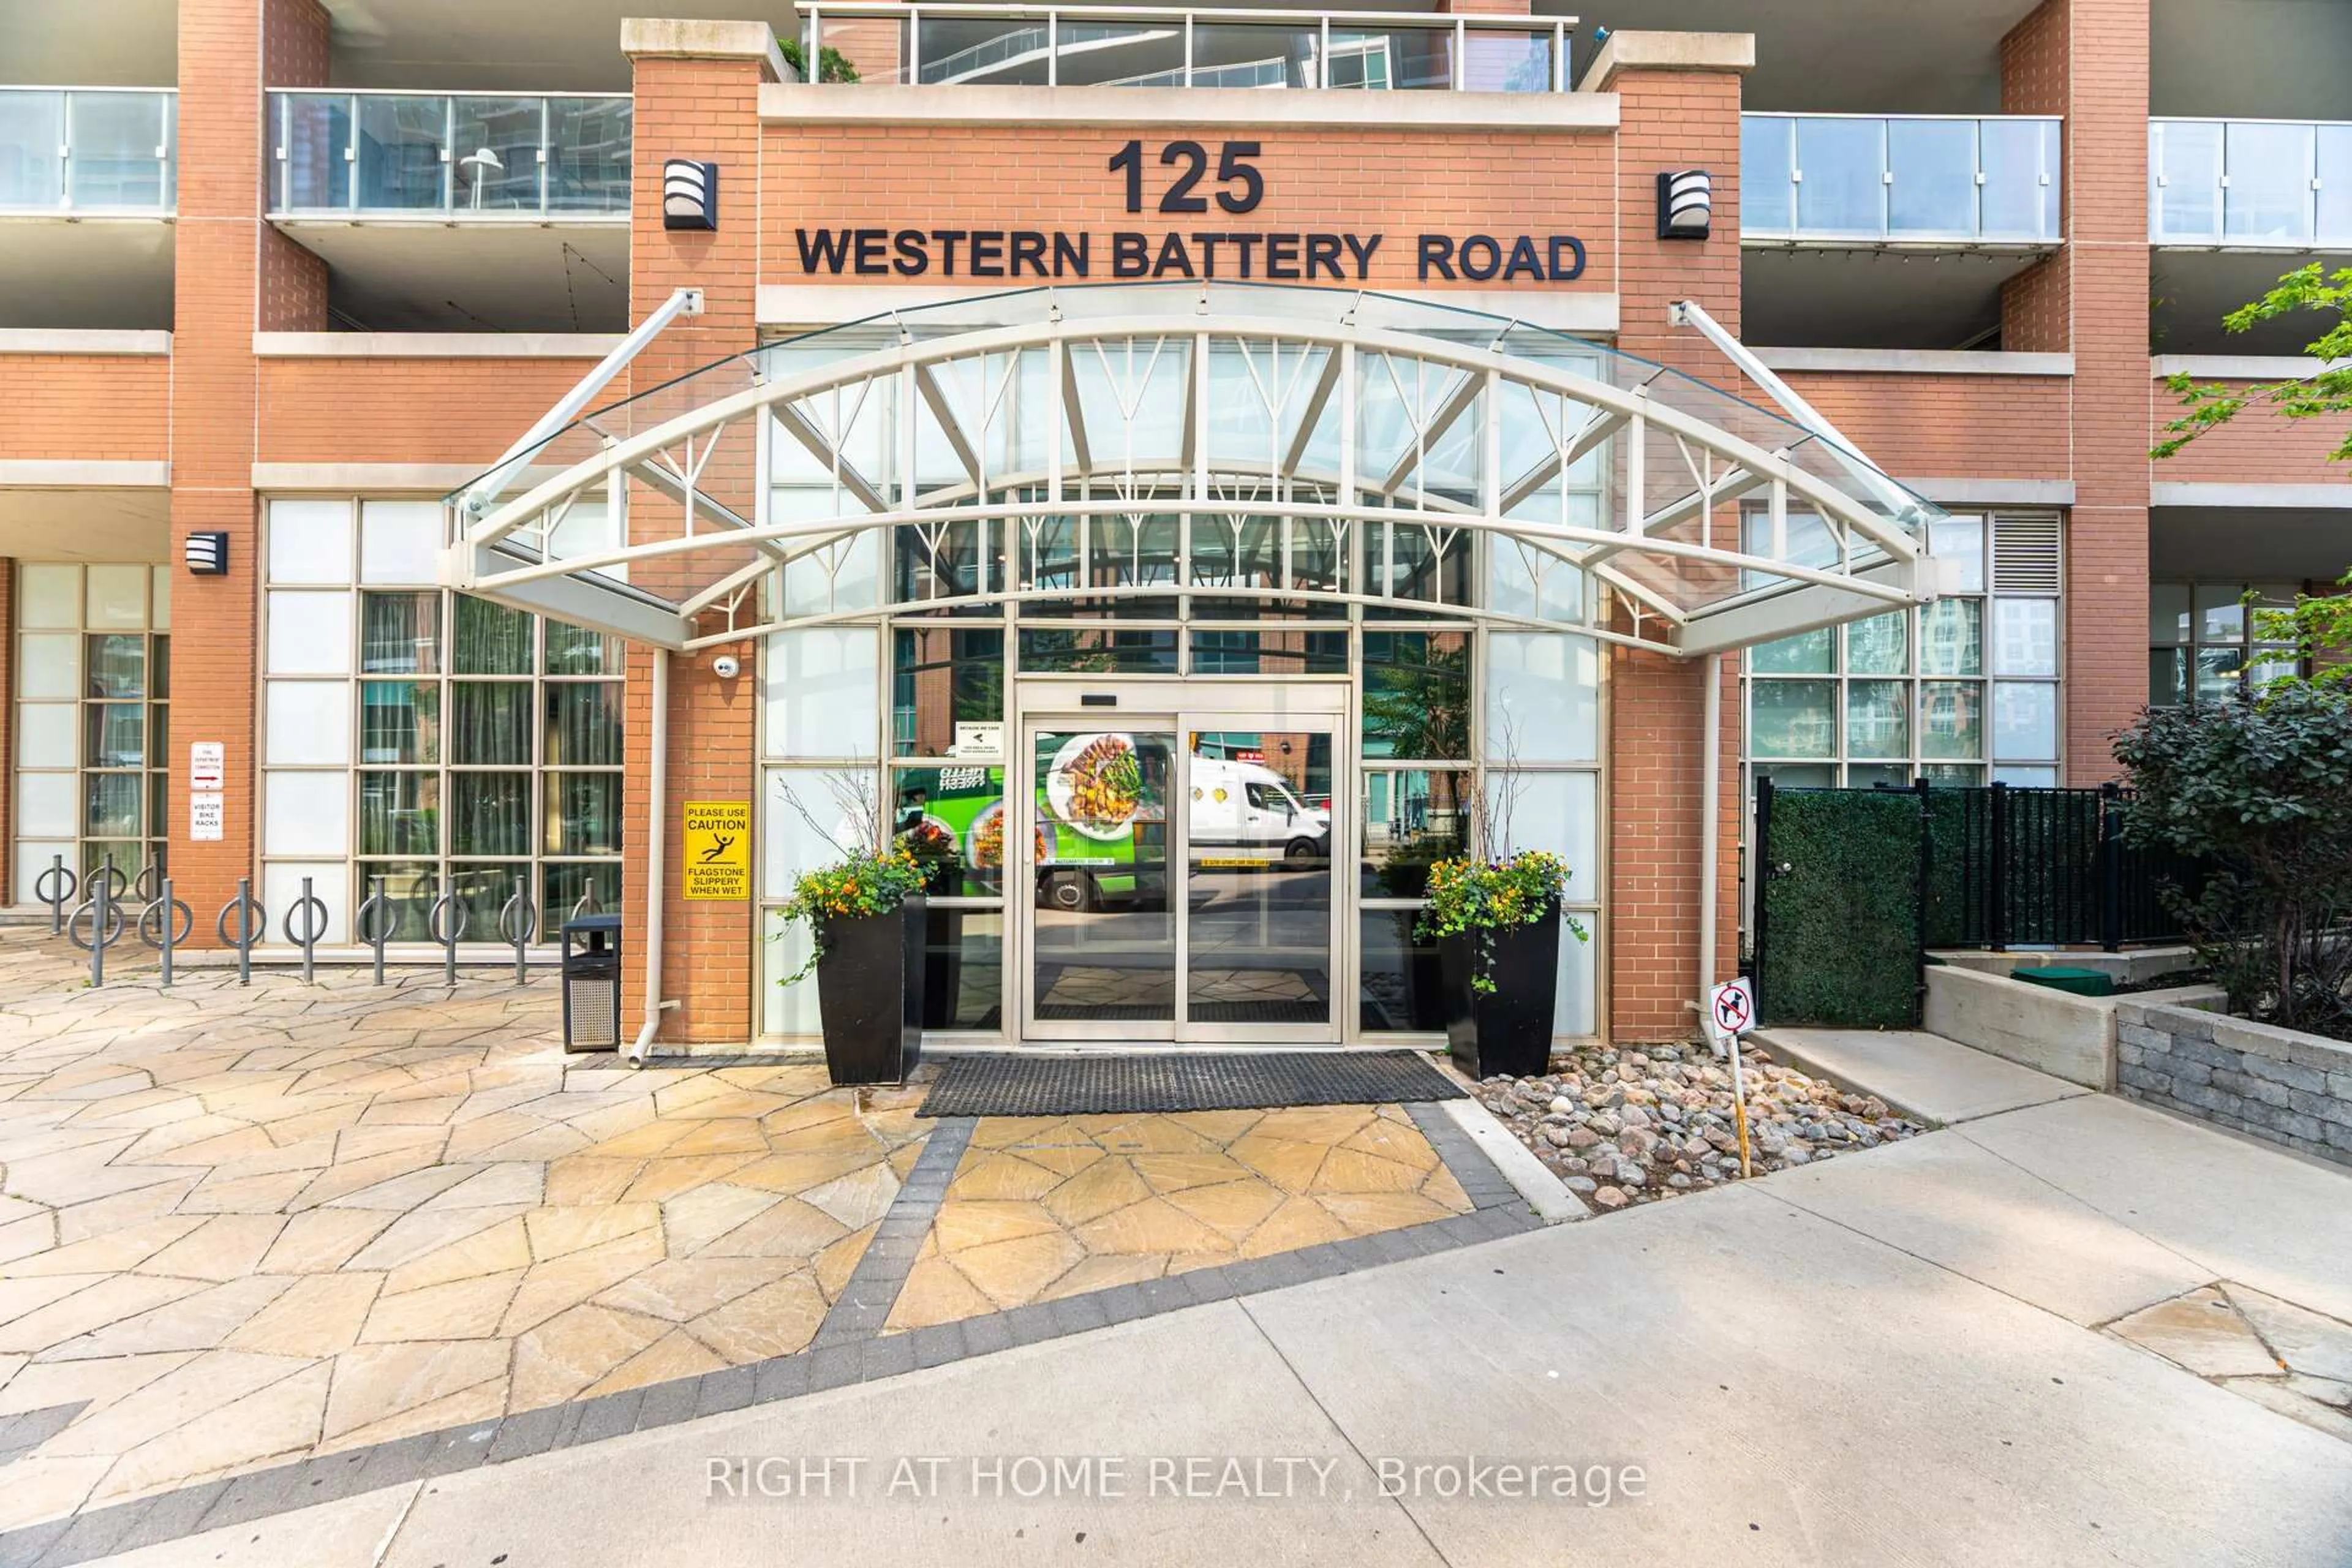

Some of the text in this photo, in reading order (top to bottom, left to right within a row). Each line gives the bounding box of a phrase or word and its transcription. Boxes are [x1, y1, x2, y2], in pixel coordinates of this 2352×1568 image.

[1109, 140, 1264, 214] 125
[795, 228, 1586, 281] WESTERN BATTERY ROAD
[688, 820, 745, 830] CAUTION
